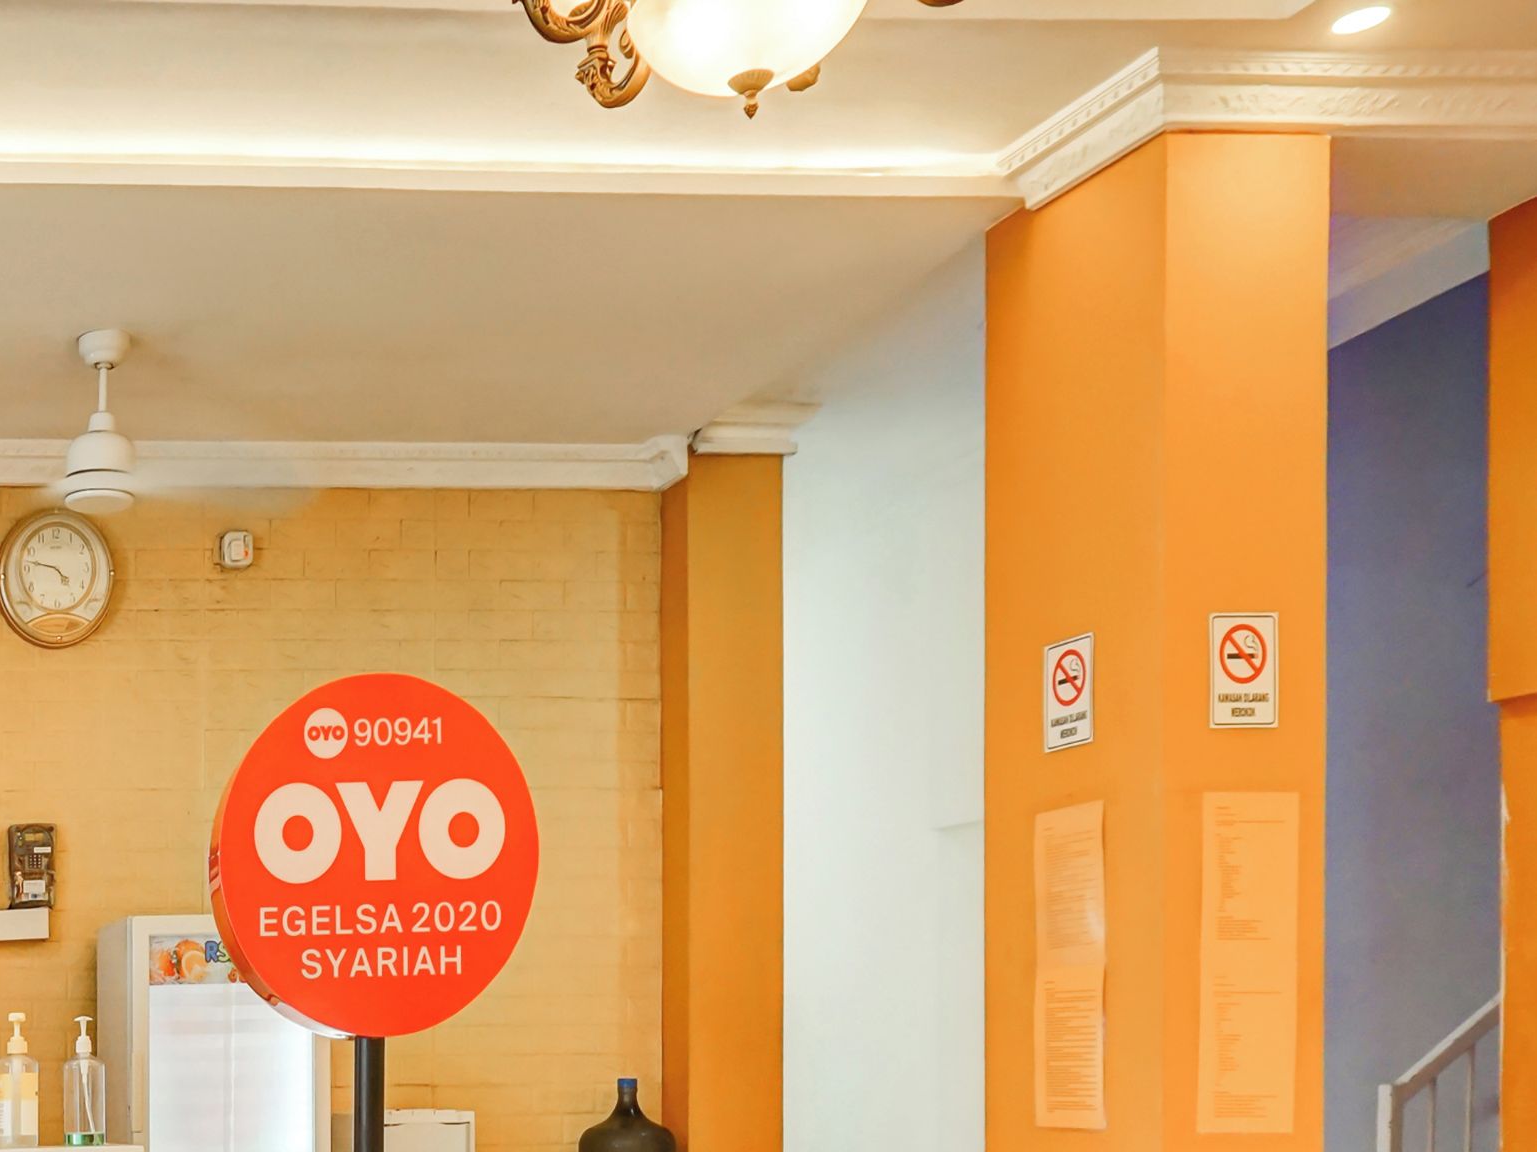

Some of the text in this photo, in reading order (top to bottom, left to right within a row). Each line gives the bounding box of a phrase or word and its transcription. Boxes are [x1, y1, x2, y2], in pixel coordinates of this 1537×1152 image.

[307, 717, 442, 747] OYO 90941
[254, 778, 506, 884] OYO
[259, 900, 502, 937] EGELSA 2020
[301, 945, 462, 979] SYARIAH
